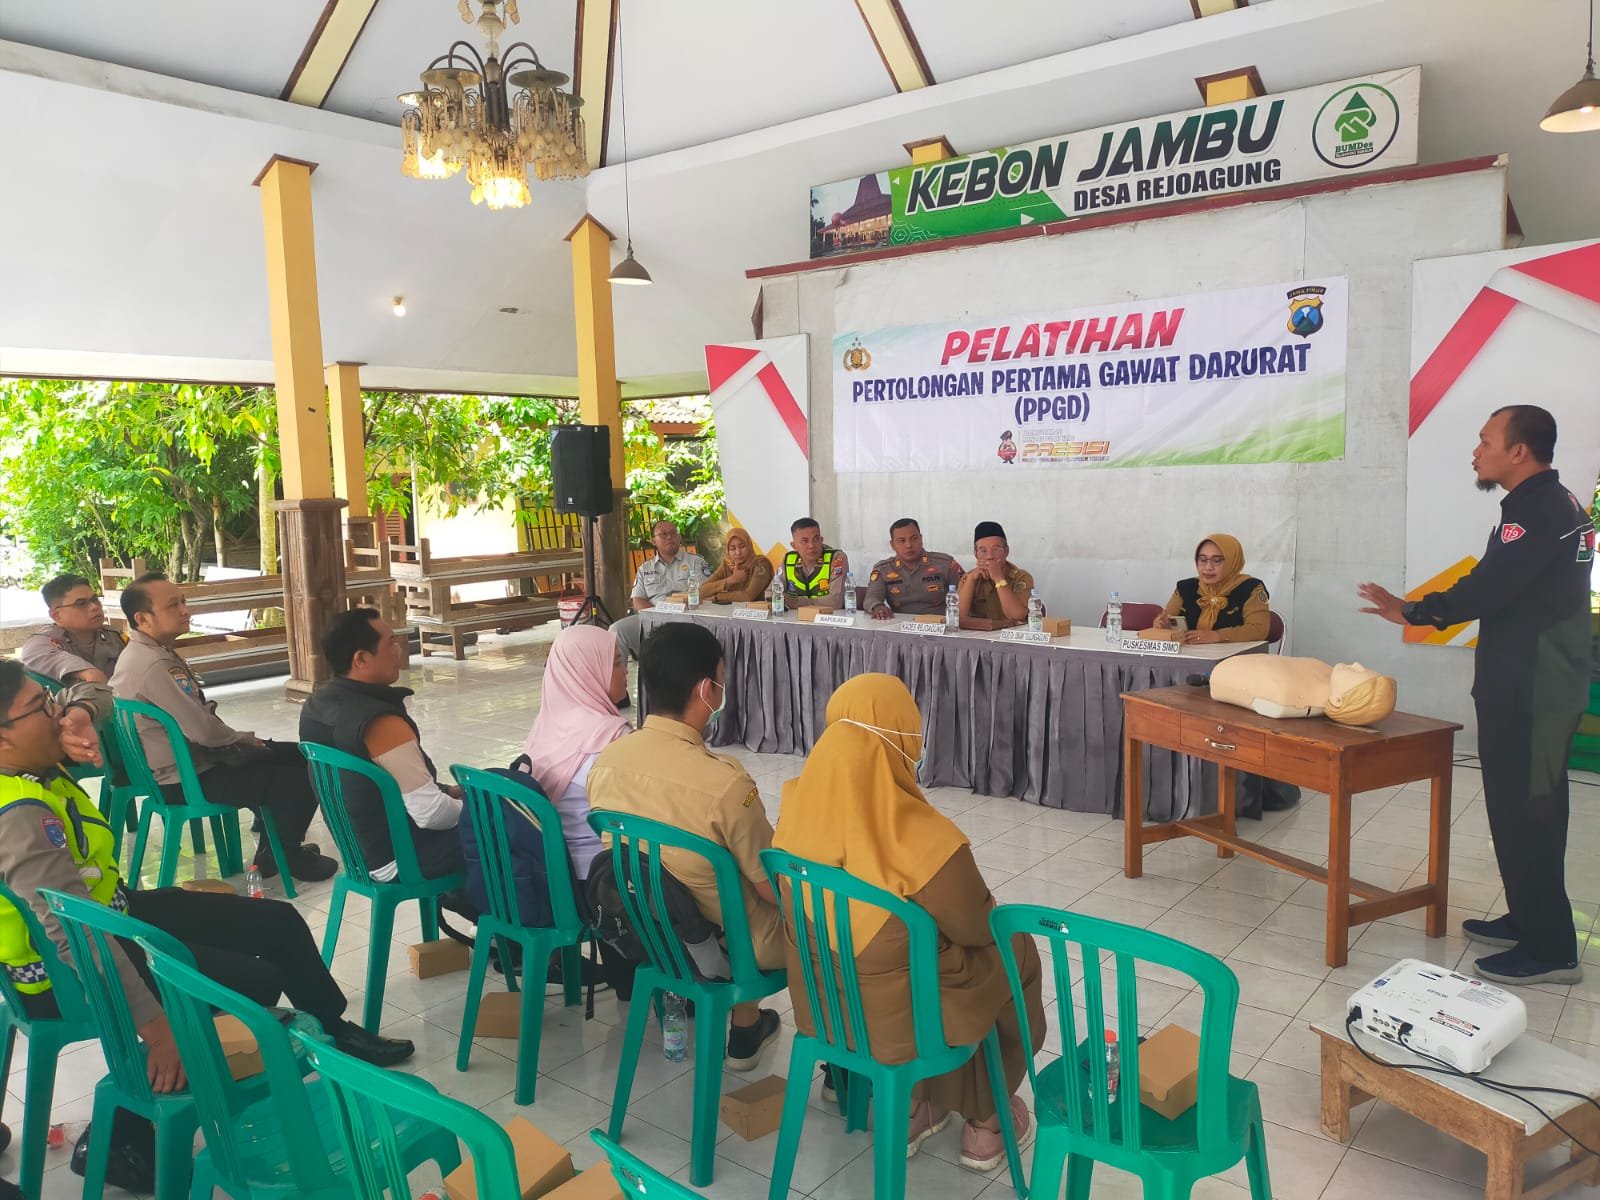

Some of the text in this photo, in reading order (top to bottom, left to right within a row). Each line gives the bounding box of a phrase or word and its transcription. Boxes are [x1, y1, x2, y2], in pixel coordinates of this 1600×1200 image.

[906, 99, 1285, 215] KEBON JAMBU
[1073, 158, 1281, 211] DESA REJOAGUNG
[940, 307, 1185, 366] PELATIHAN
[852, 343, 1312, 403] PERTOLONGAN PERTAMA GAWAT DARURAT
[1014, 392, 1090, 425] (PPGD)
[1122, 639, 1179, 653] PUSKESMAS SIMO
